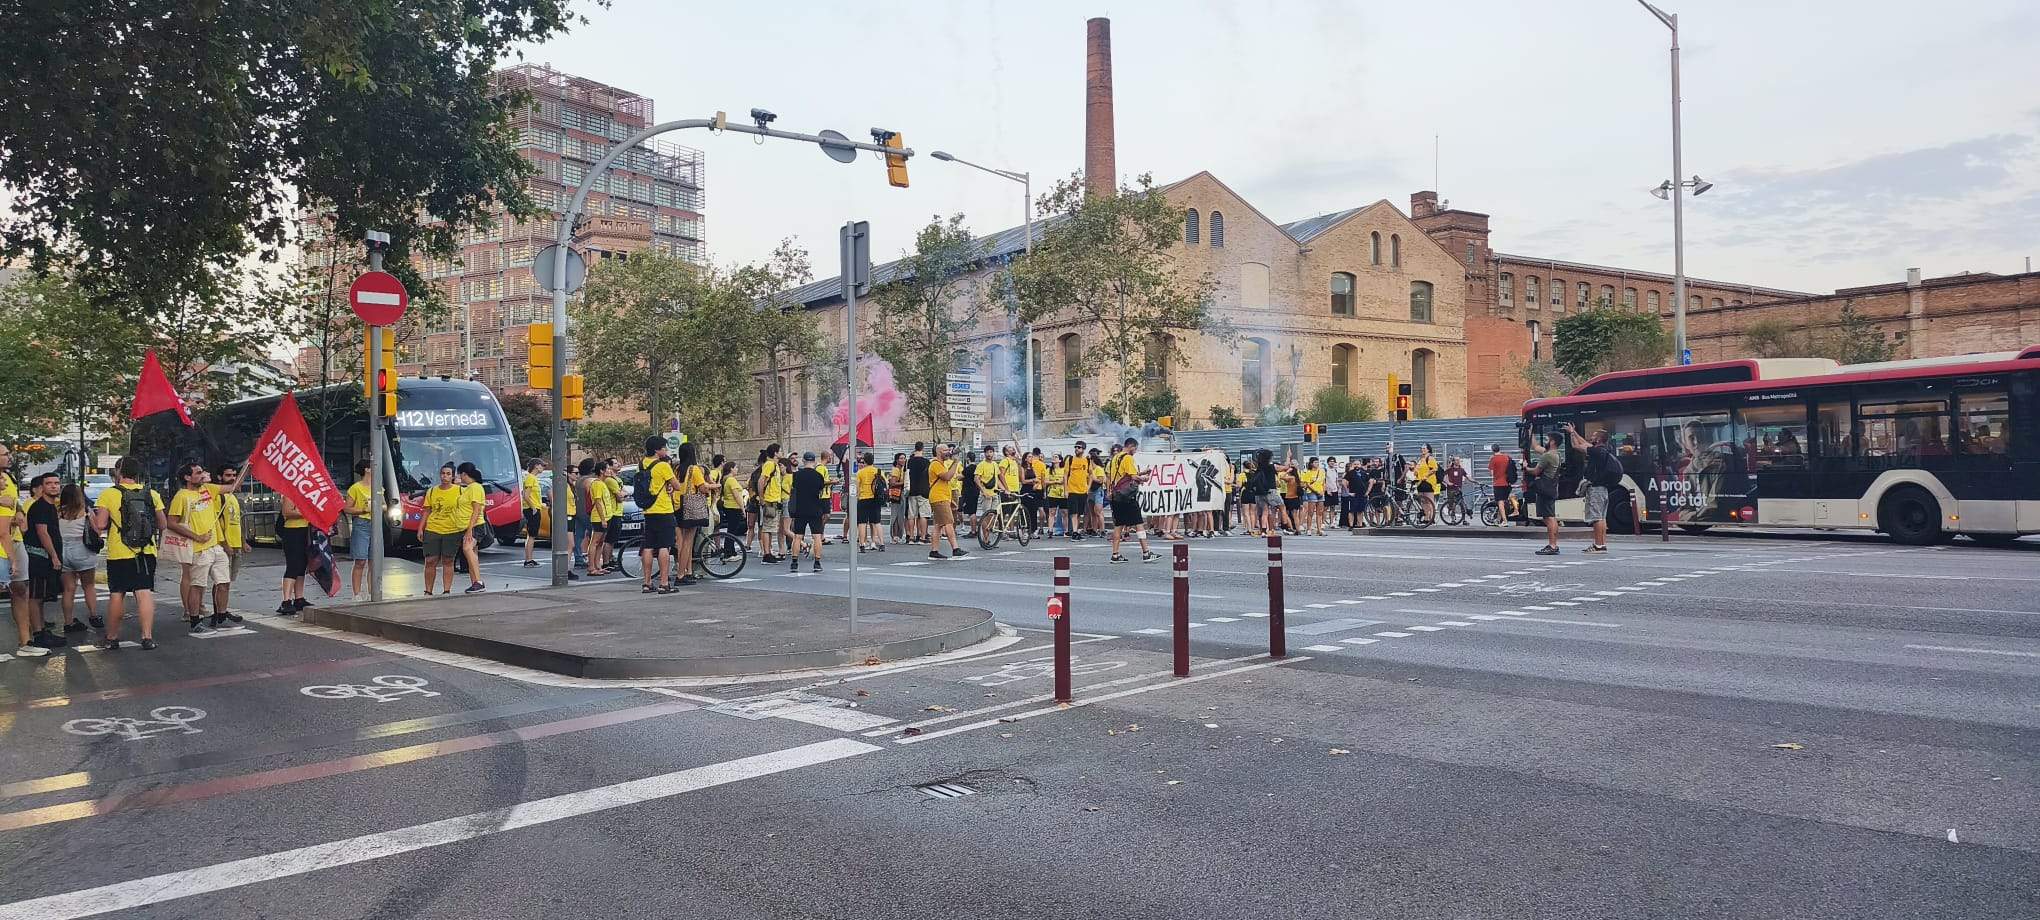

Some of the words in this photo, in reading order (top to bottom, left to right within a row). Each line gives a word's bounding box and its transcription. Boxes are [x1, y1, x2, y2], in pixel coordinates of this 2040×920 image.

[396, 411, 424, 427] H12
[425, 411, 487, 426] Verneda
[272, 430, 315, 477] INTER
[262, 442, 329, 512] SINDICAL
[1648, 477, 1658, 491] A
[1661, 480, 1692, 494] prop
[1138, 486, 1192, 513] DUCATIVA
[1670, 493, 1686, 506] de
